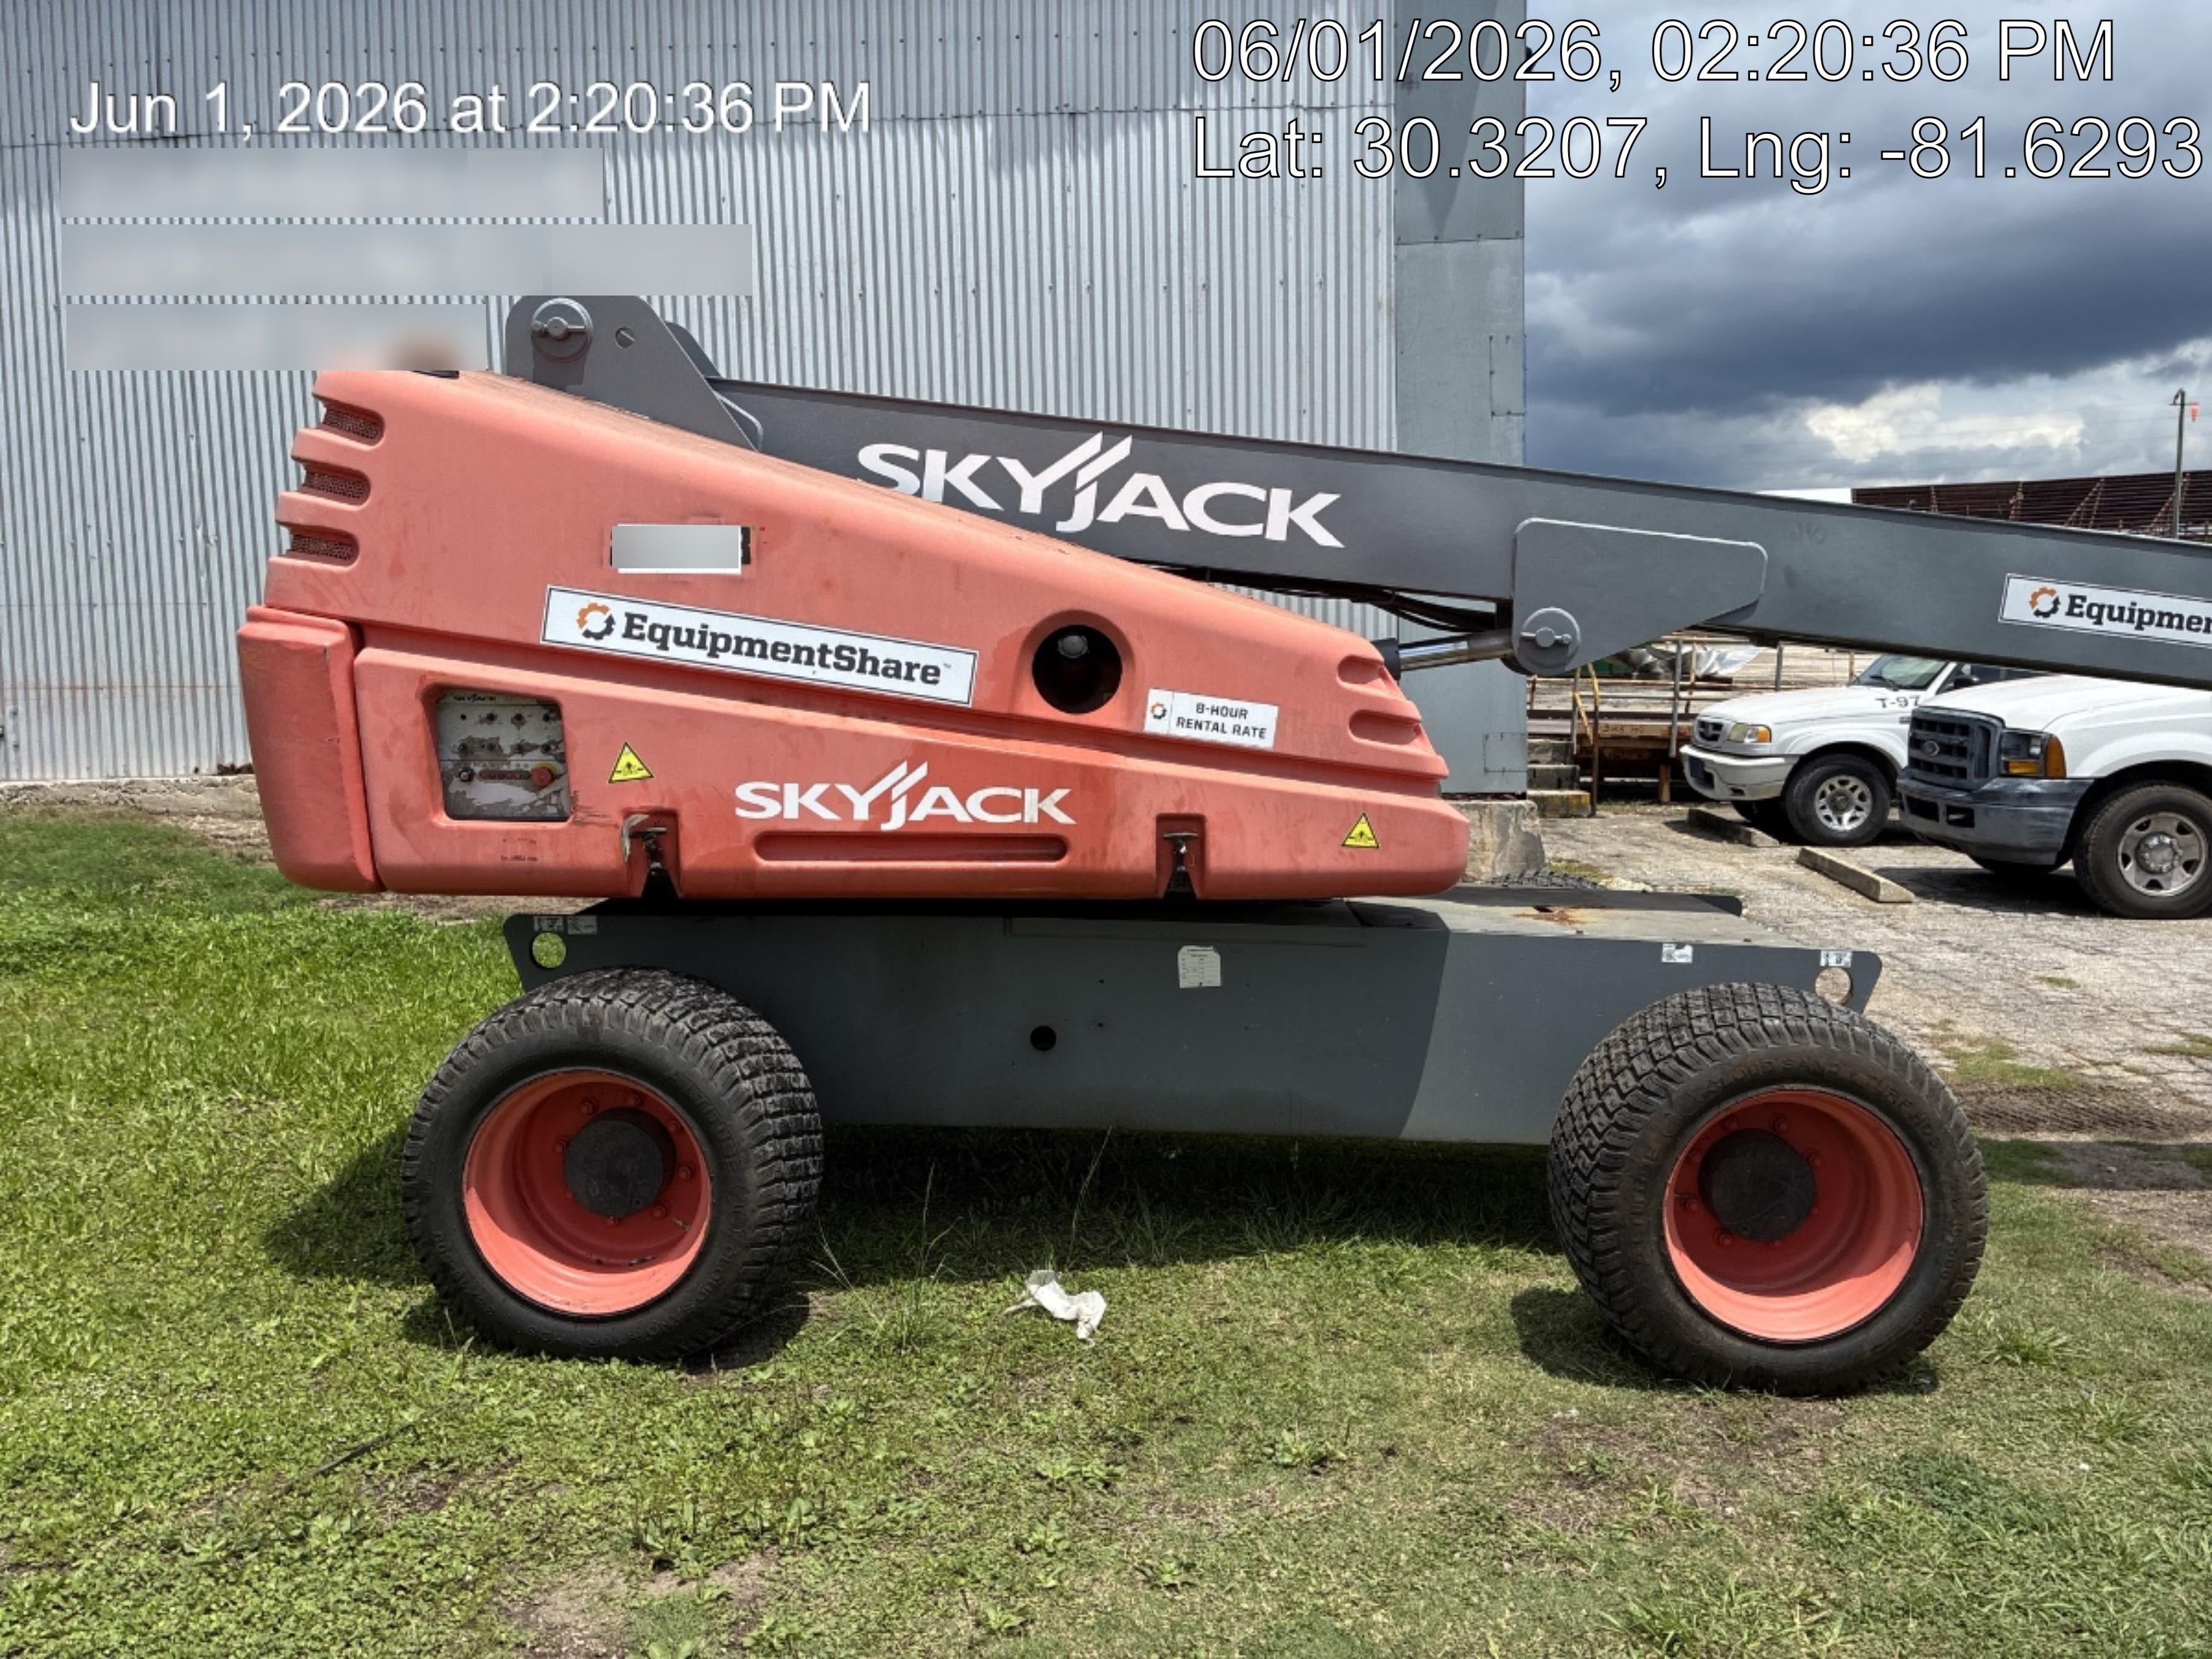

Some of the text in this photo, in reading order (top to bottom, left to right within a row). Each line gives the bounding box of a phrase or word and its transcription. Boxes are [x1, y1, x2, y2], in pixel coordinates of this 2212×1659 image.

[857, 431, 1345, 549] SKYJACK
[621, 612, 941, 686] EquipmentShare
[1176, 716, 1266, 739] RENTAL RATE
[1196, 702, 1249, 720] 8-HOUR
[734, 760, 1077, 831] SKYJACK
